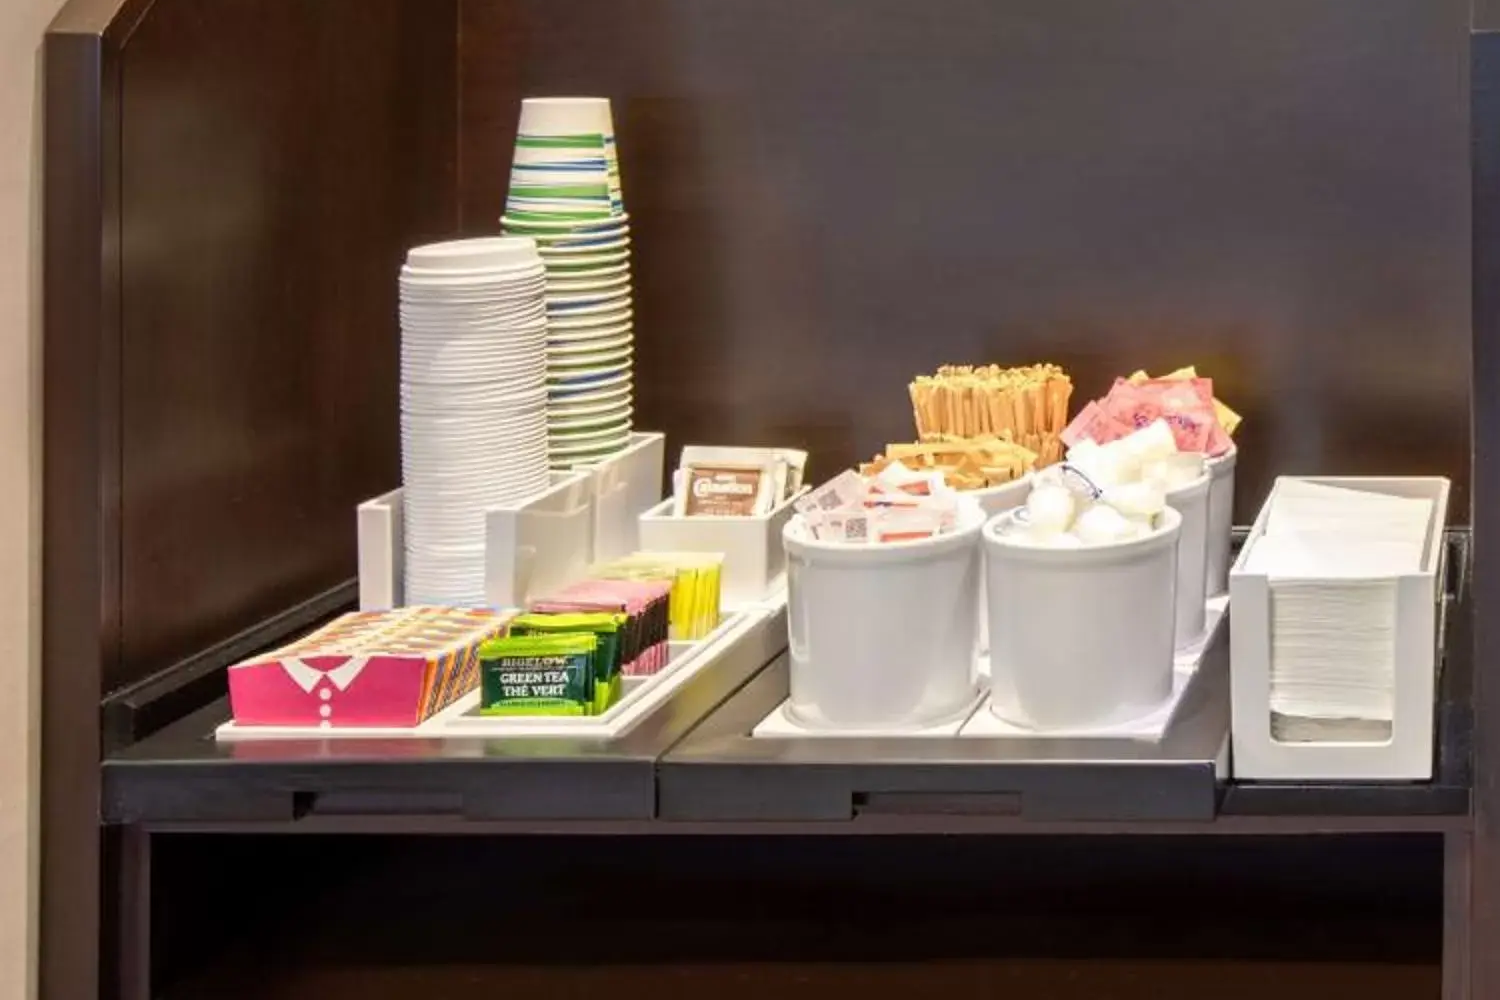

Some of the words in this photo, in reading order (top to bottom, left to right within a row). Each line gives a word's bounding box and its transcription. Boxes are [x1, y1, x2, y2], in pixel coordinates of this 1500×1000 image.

[500, 671, 544, 684] GREEN
[545, 670, 570, 683] TEA
[503, 683, 530, 697] THÉ
[531, 683, 567, 697] VERT
